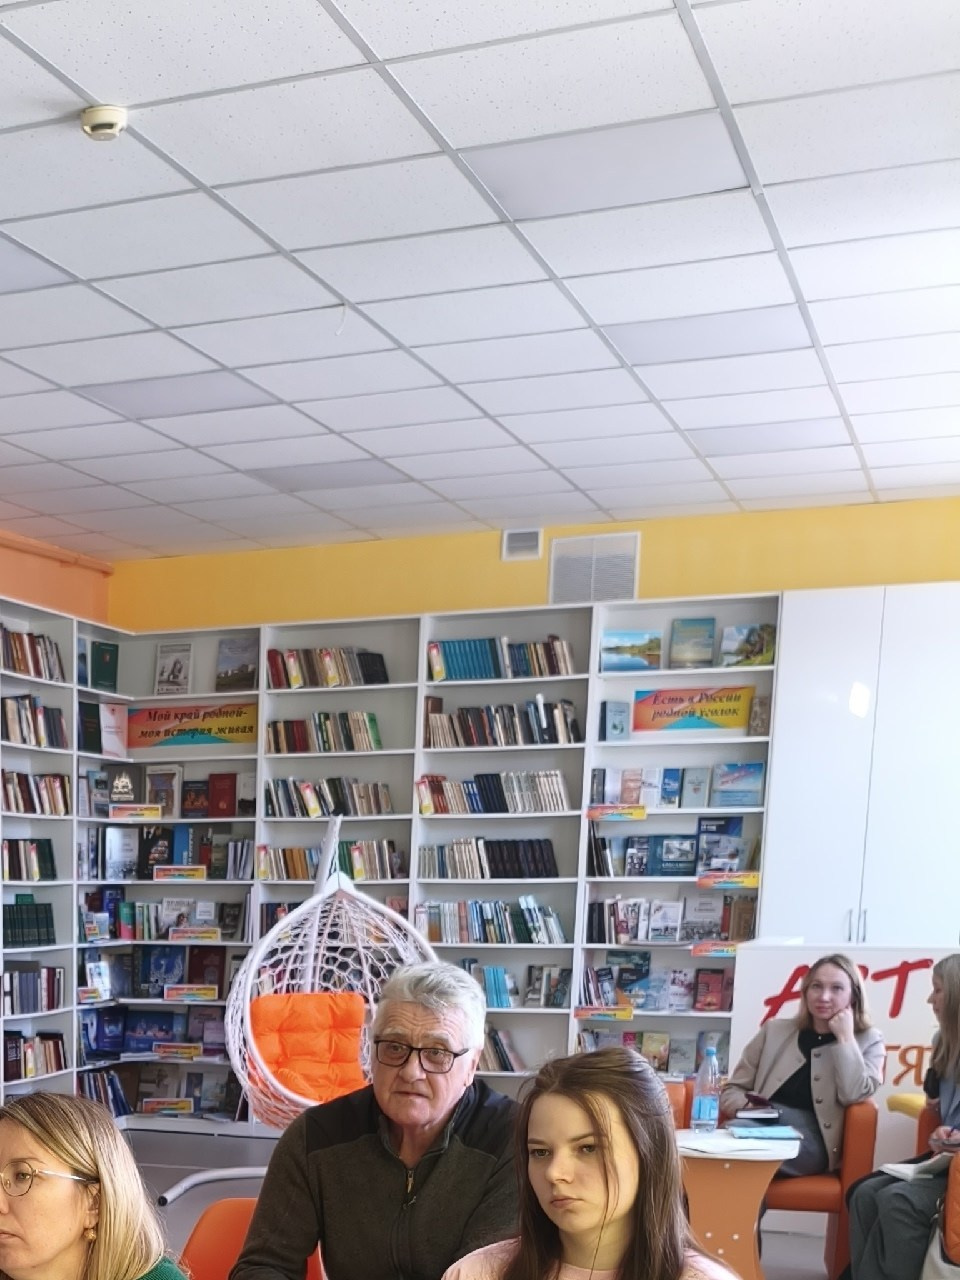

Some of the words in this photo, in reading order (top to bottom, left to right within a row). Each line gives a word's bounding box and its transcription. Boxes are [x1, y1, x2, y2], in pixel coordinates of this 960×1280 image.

[146, 710, 171, 721] Мой
[174, 709, 200, 723] край
[138, 729, 161, 739] моя
[163, 727, 213, 739] история
[214, 725, 254, 736] живая
